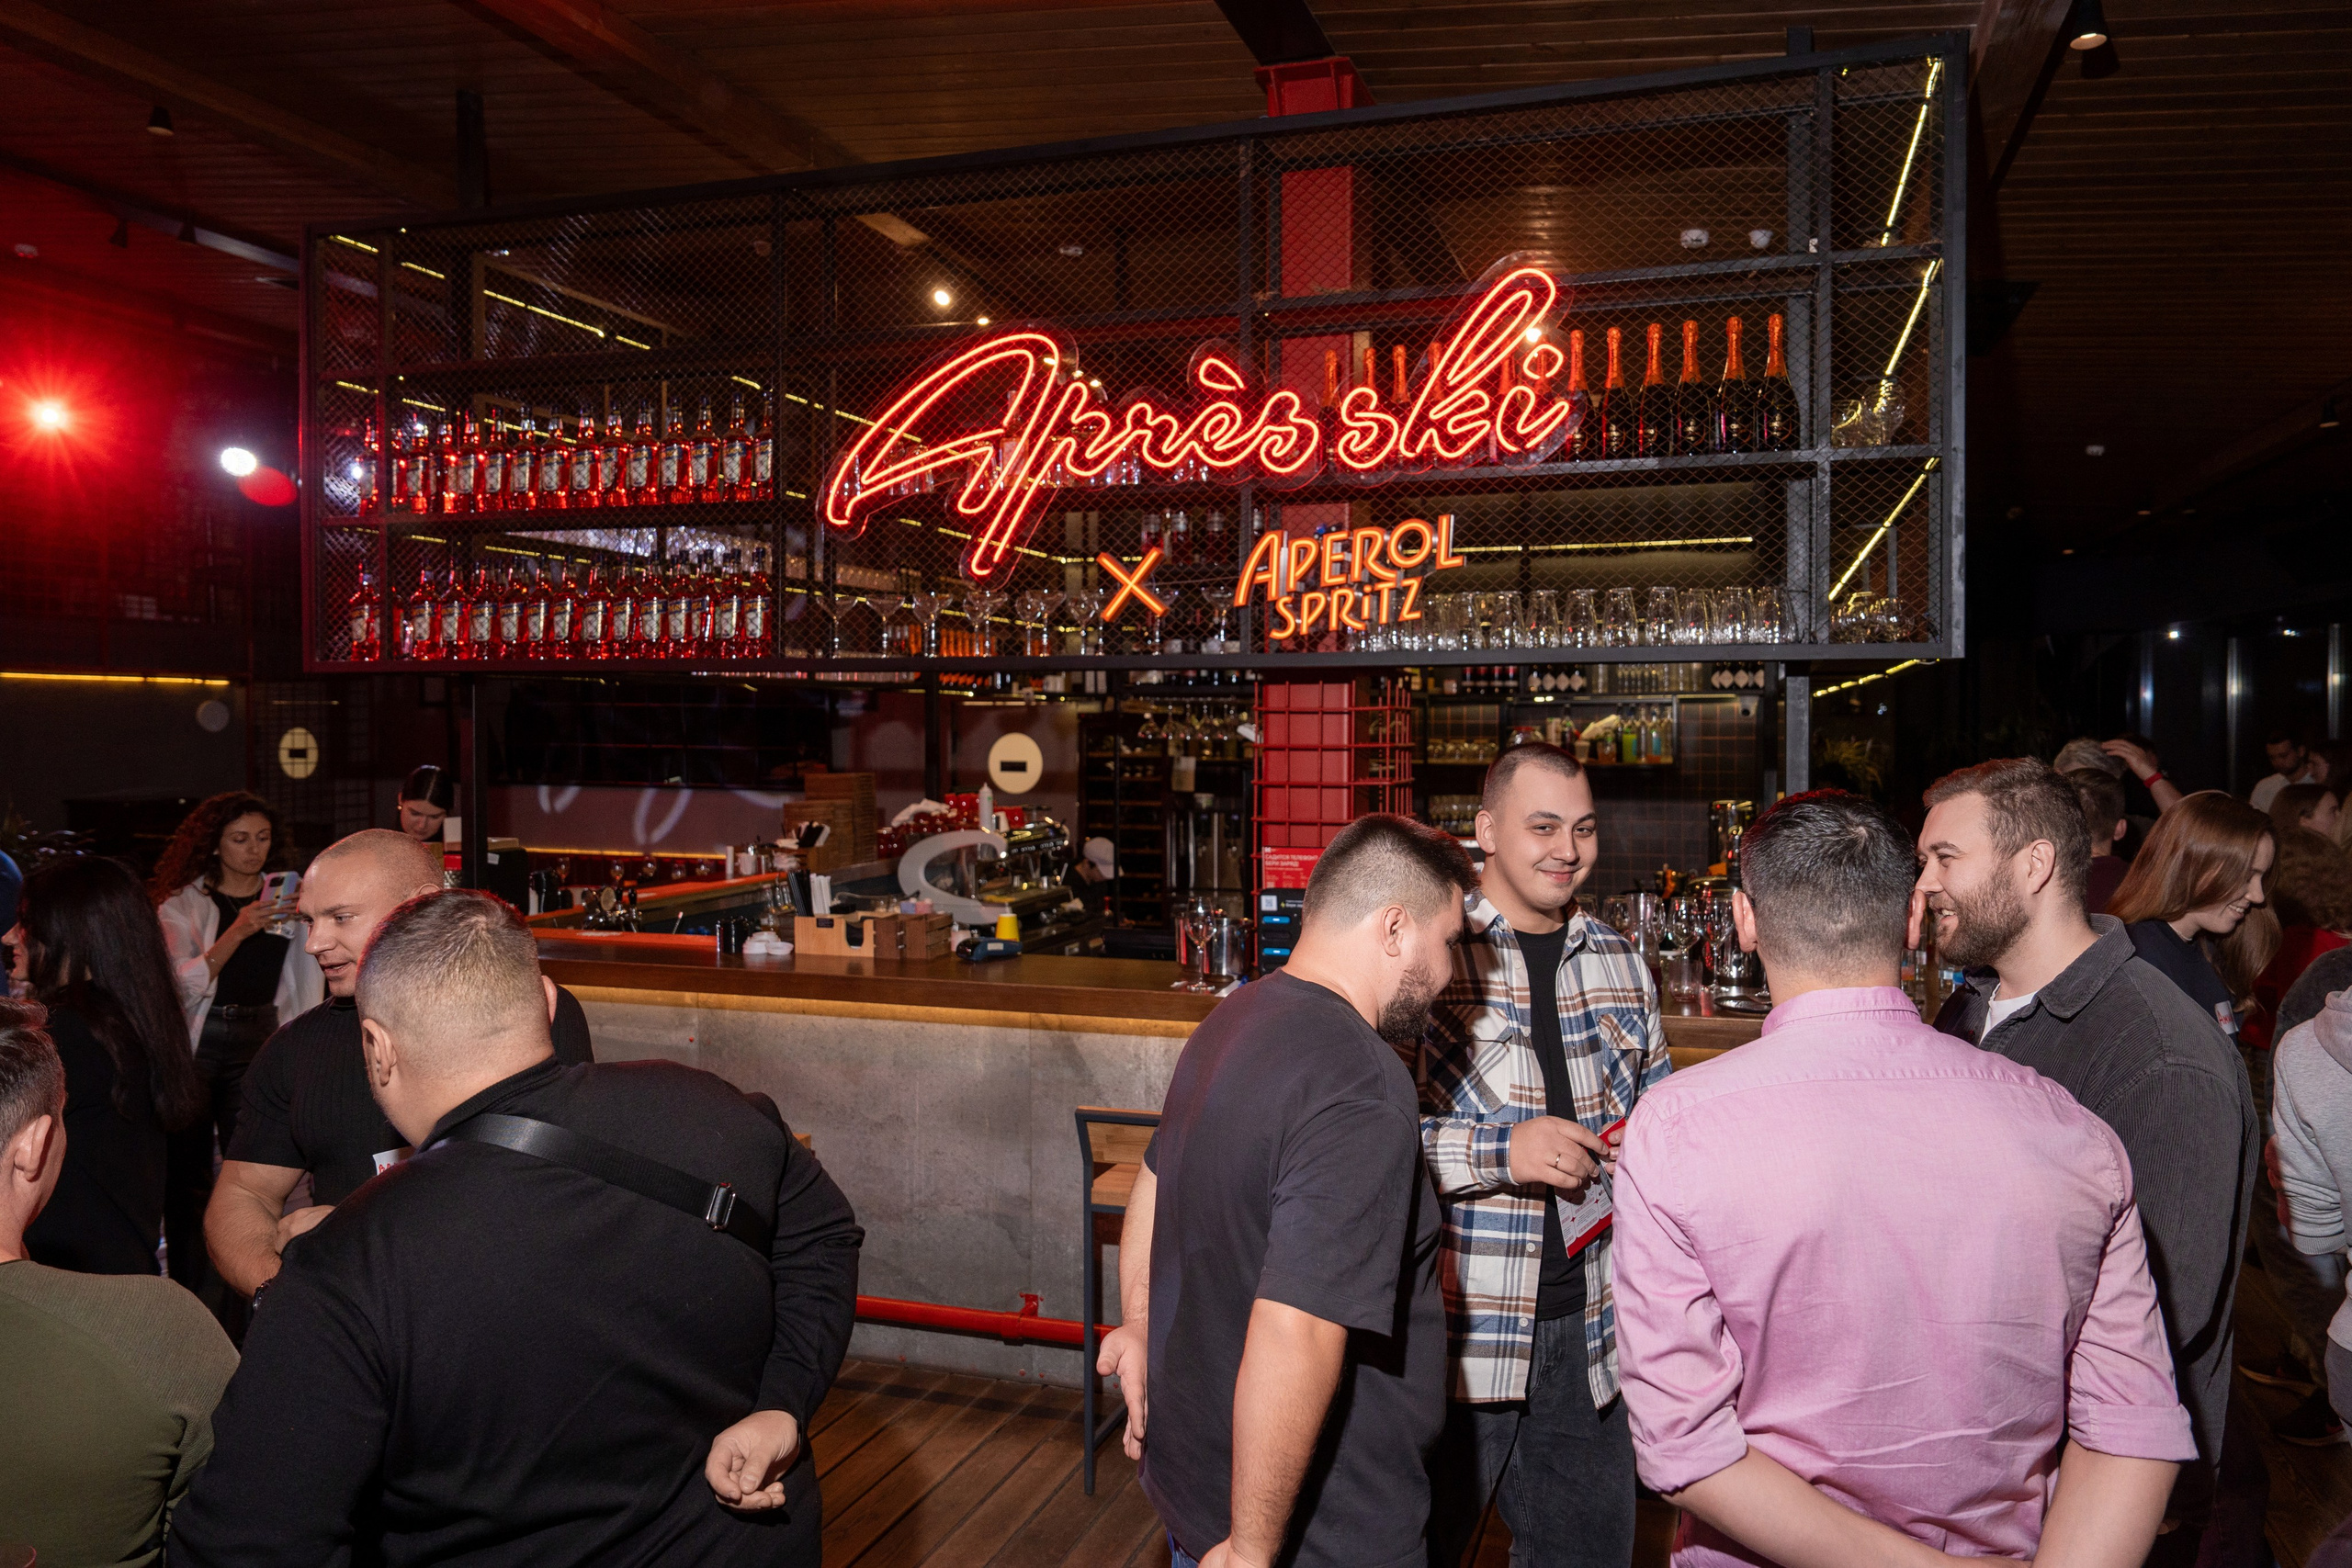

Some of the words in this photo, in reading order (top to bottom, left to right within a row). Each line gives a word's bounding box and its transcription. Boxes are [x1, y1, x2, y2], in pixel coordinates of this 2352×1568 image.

[825, 332, 1321, 577] Après
[1335, 265, 1572, 471] ski
[1234, 513, 1465, 607] APEROL
